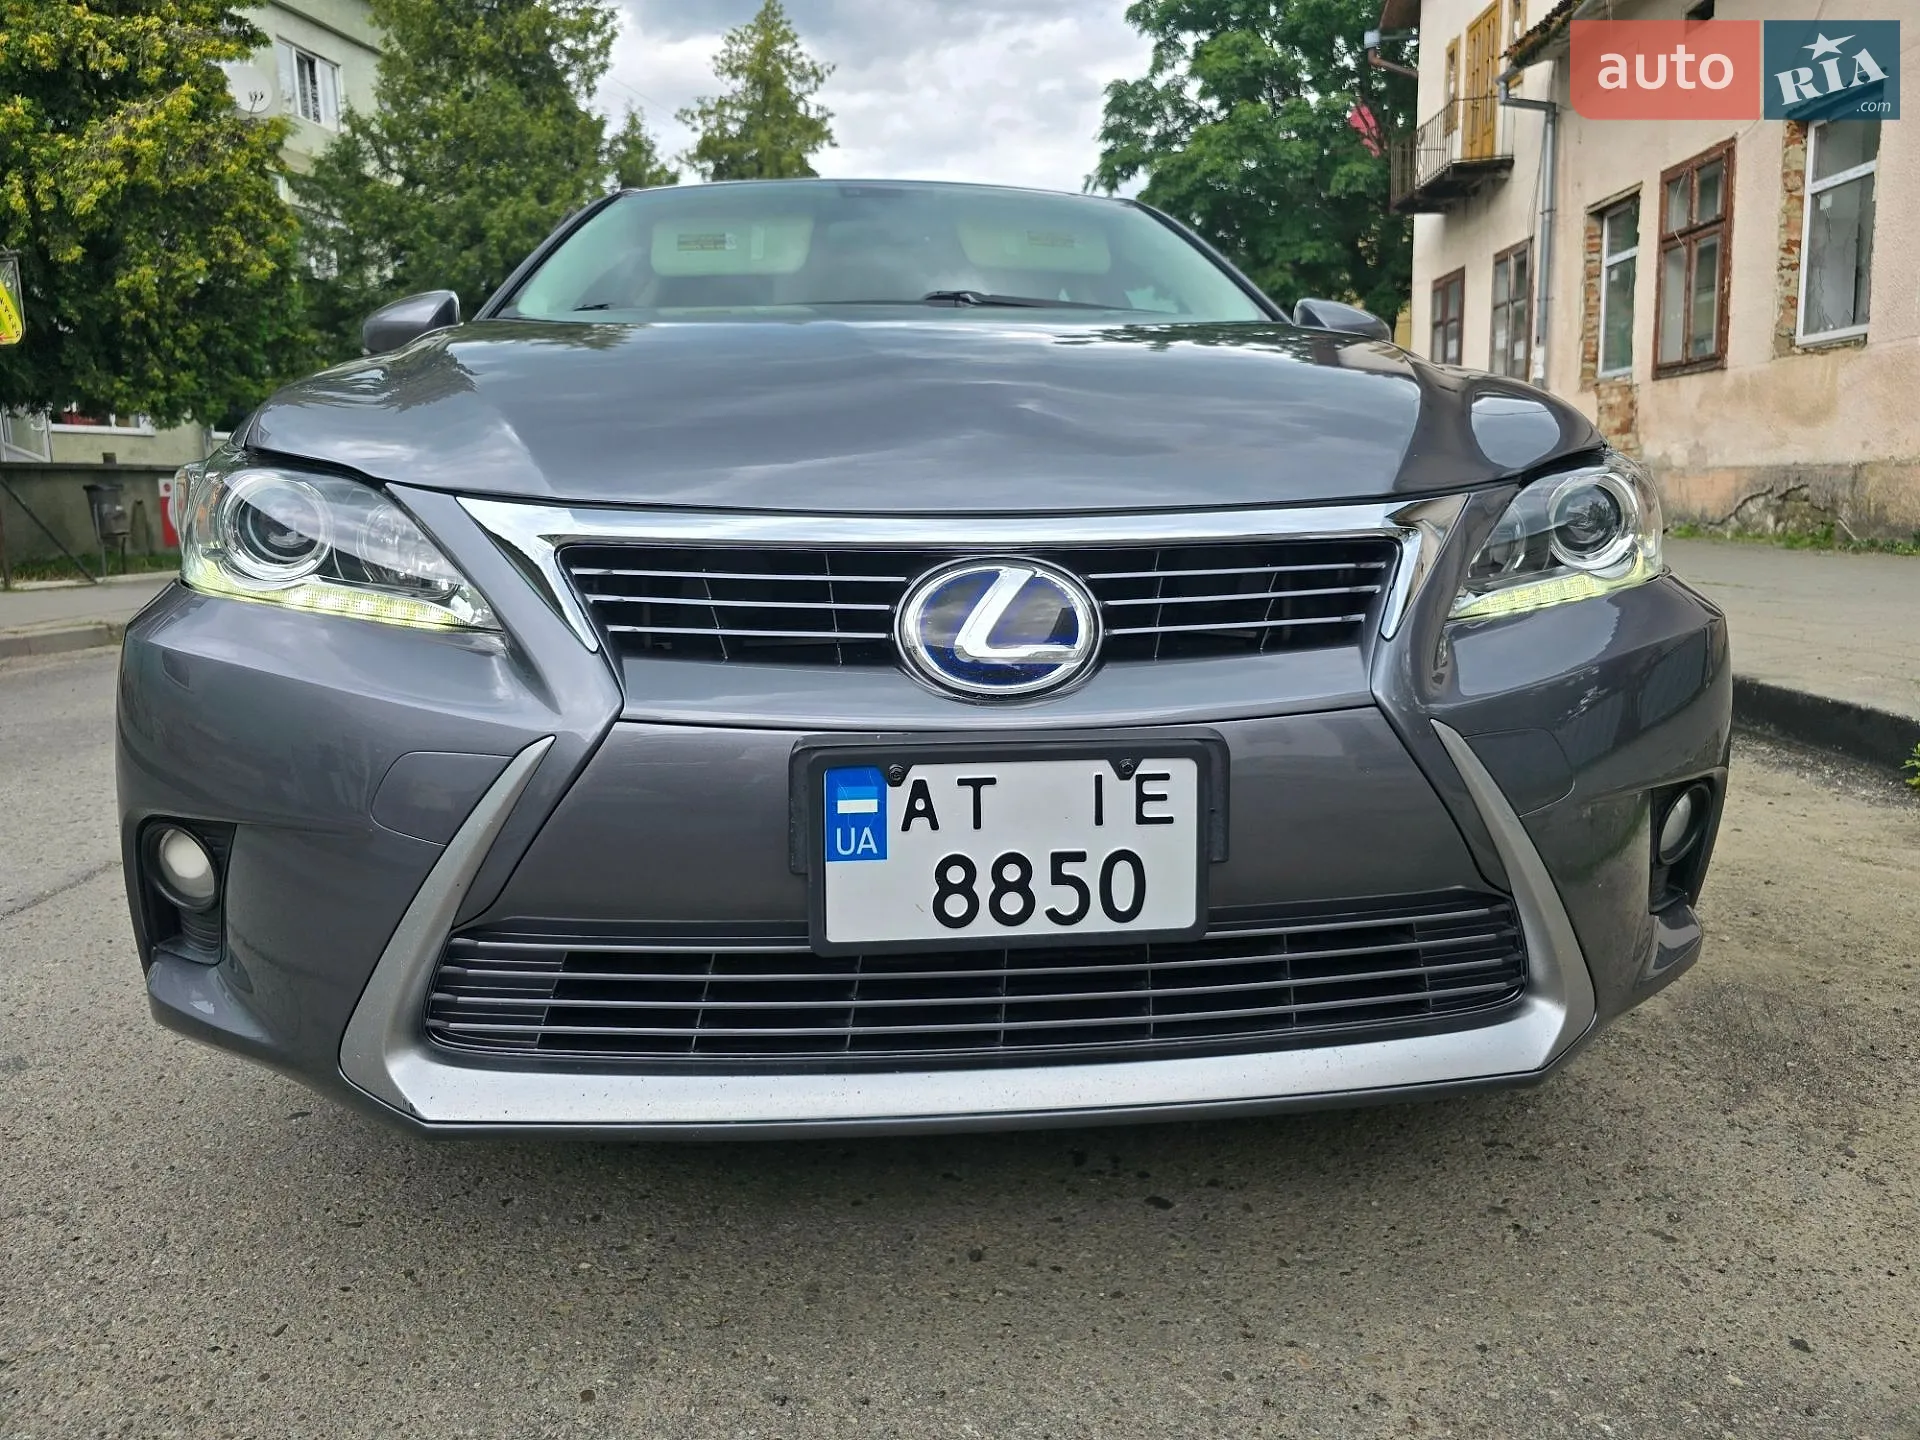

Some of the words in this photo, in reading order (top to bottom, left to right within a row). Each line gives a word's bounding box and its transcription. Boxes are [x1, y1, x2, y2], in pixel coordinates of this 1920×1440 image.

[901, 777, 997, 832] AT
[1094, 773, 1175, 827] IE
[836, 828, 878, 856] UA
[932, 848, 1146, 929] 8850
